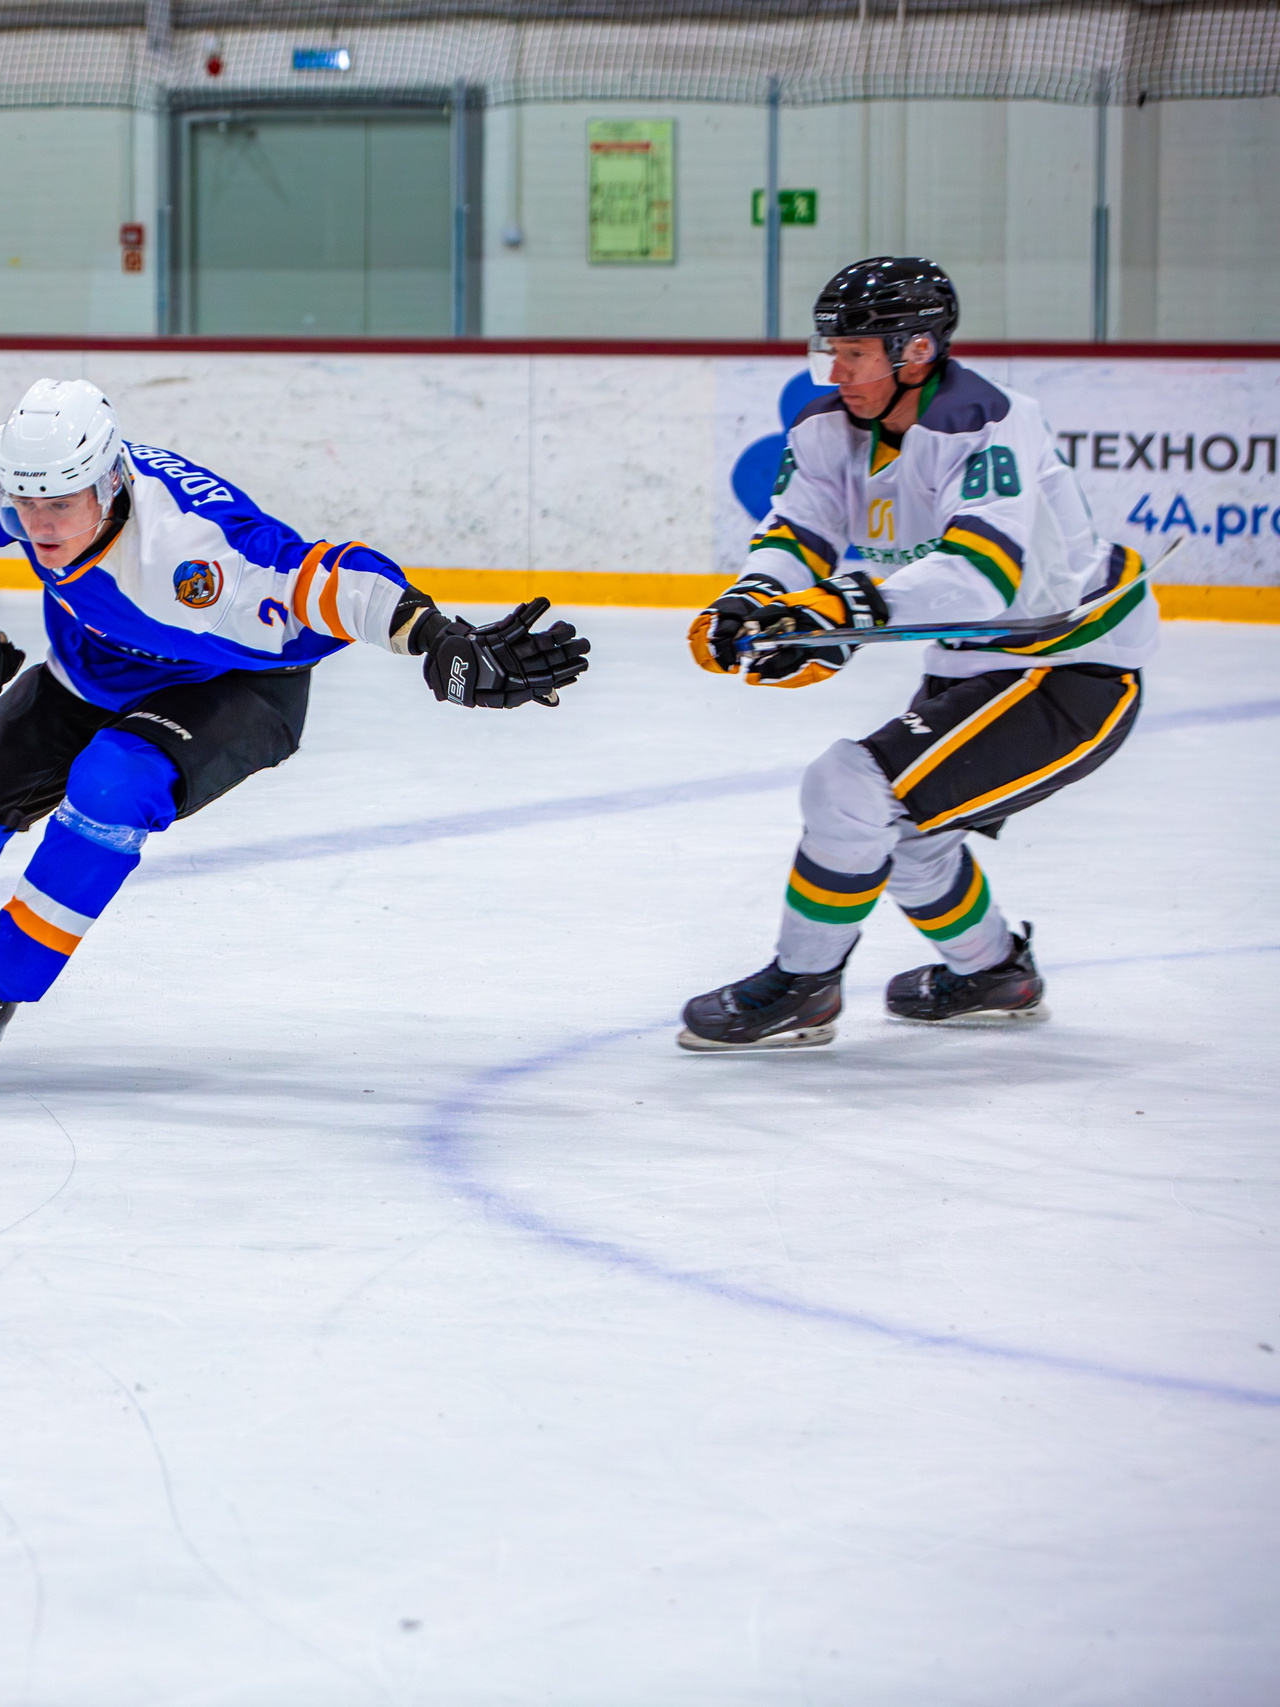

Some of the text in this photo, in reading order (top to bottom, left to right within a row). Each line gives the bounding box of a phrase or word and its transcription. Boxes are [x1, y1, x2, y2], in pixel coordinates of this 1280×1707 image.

[960, 444, 1023, 500] 88
[1056, 431, 1278, 475] ТЕХНОЛ
[257, 596, 289, 628] 2
